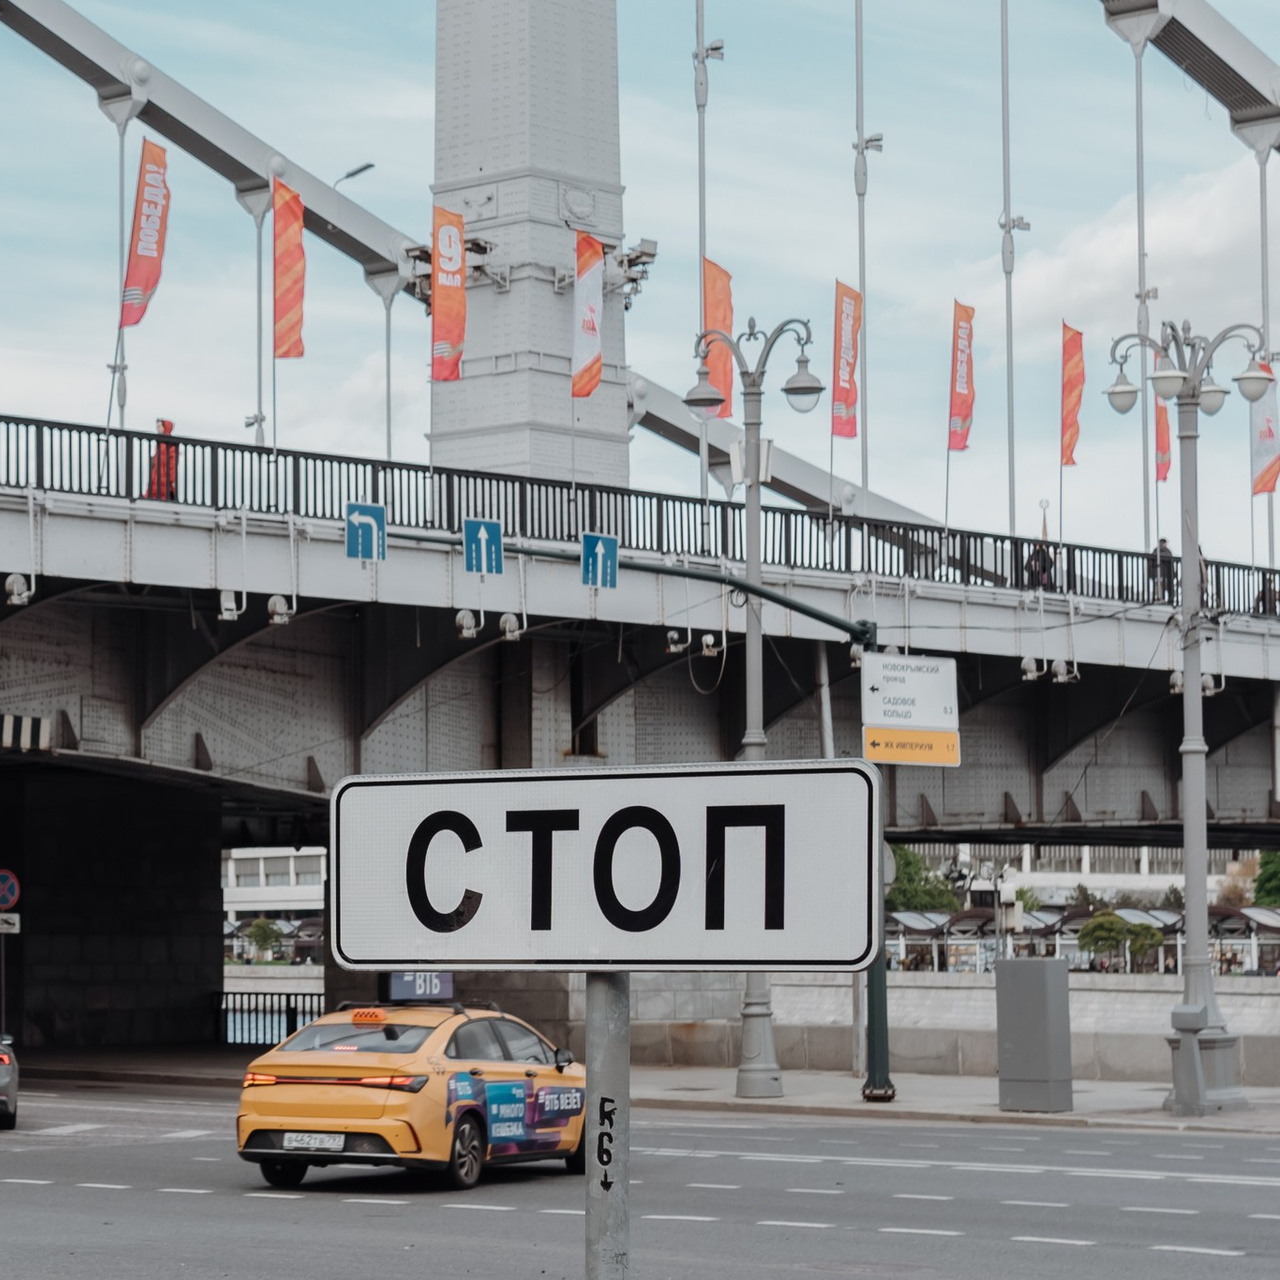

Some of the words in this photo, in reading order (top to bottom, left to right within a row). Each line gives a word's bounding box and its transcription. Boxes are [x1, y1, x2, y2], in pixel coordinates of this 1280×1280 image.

[137, 163, 167, 258] ПОБЕДА!
[438, 225, 462, 272] 9
[438, 272, 461, 287] МАЯ
[406, 804, 785, 933] СТОП
[415, 972, 441, 995] ВТБ
[545, 1094, 559, 1111] ВТБ
[560, 1089, 581, 1110] ВЕЗЁТ
